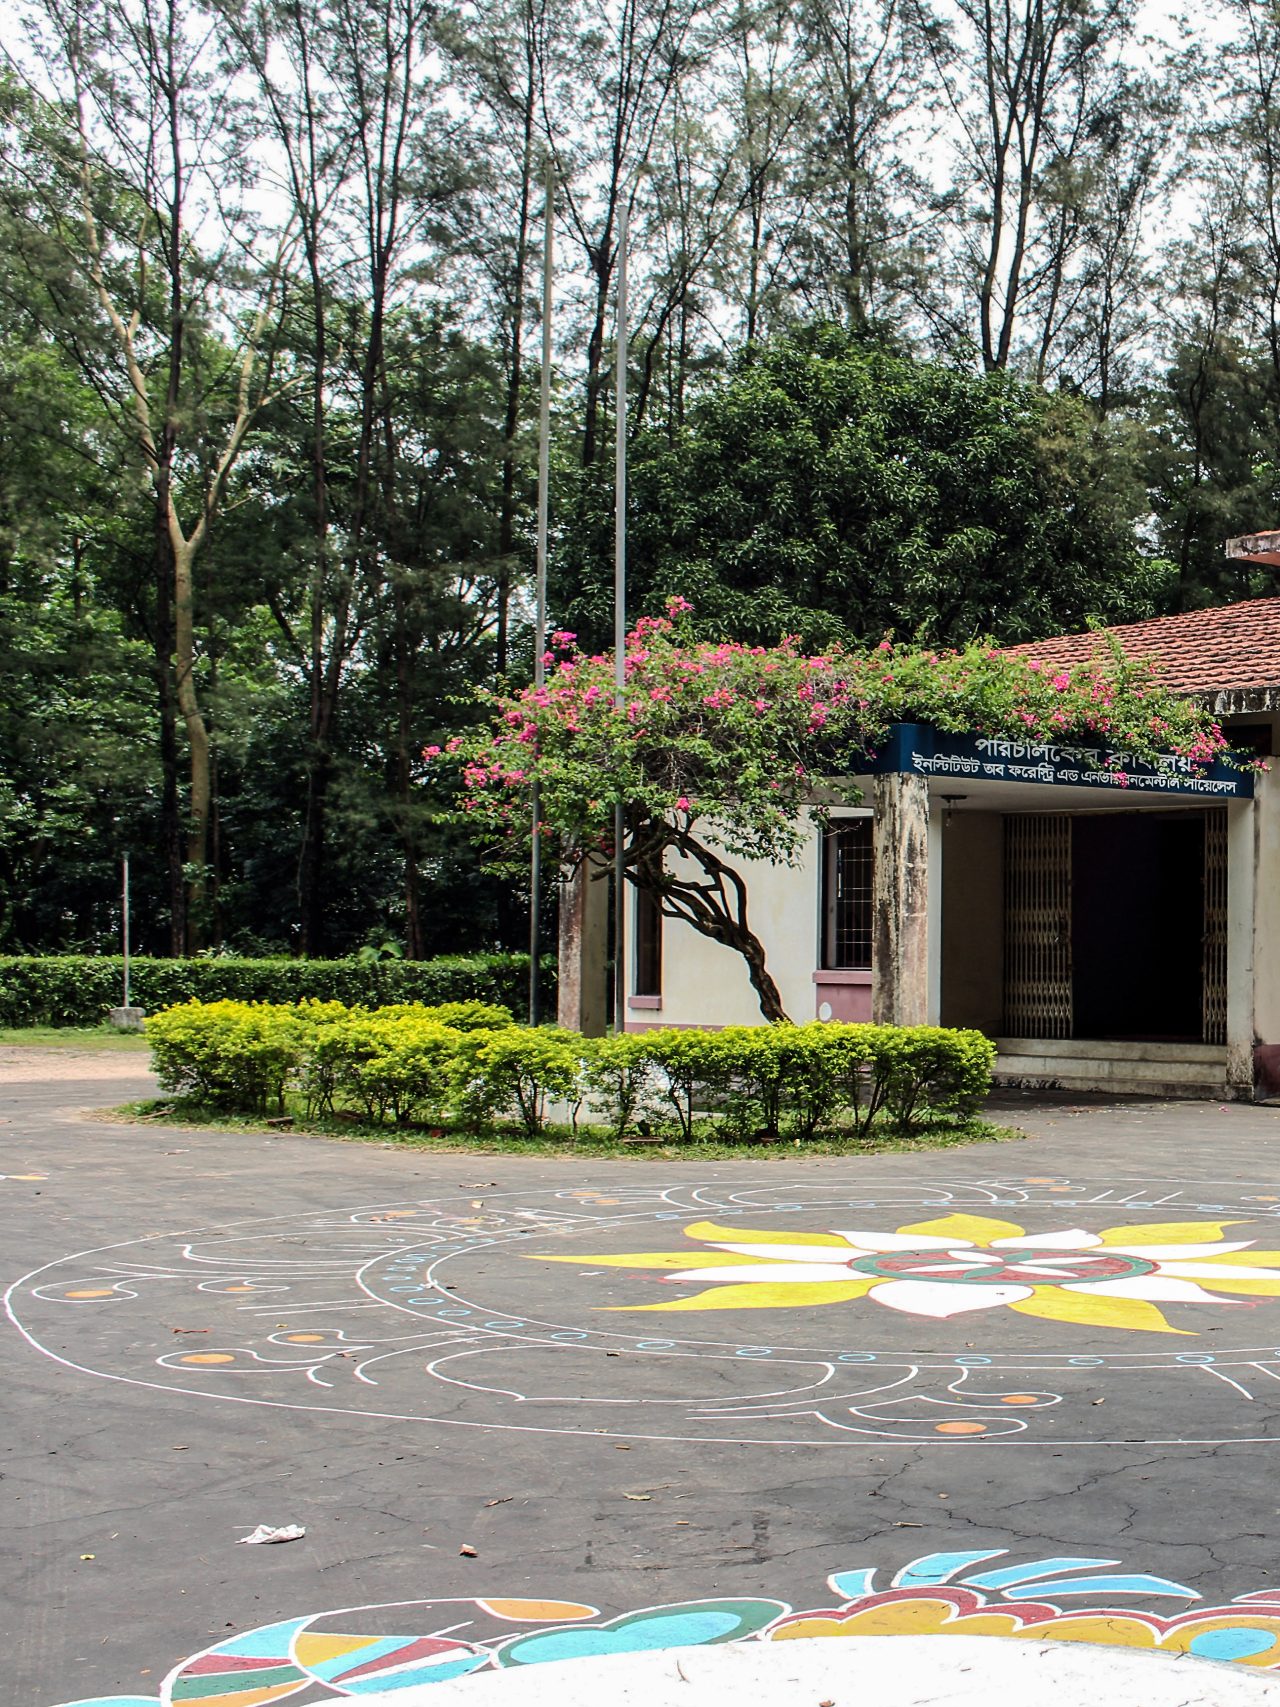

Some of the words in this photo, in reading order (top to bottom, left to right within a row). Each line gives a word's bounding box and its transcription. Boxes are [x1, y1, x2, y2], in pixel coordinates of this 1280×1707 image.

[912, 751, 981, 774] ইনস্টিটিউট
[983, 763, 1006, 777] অব
[1007, 762, 1056, 783] ফরেস্ট্রি
